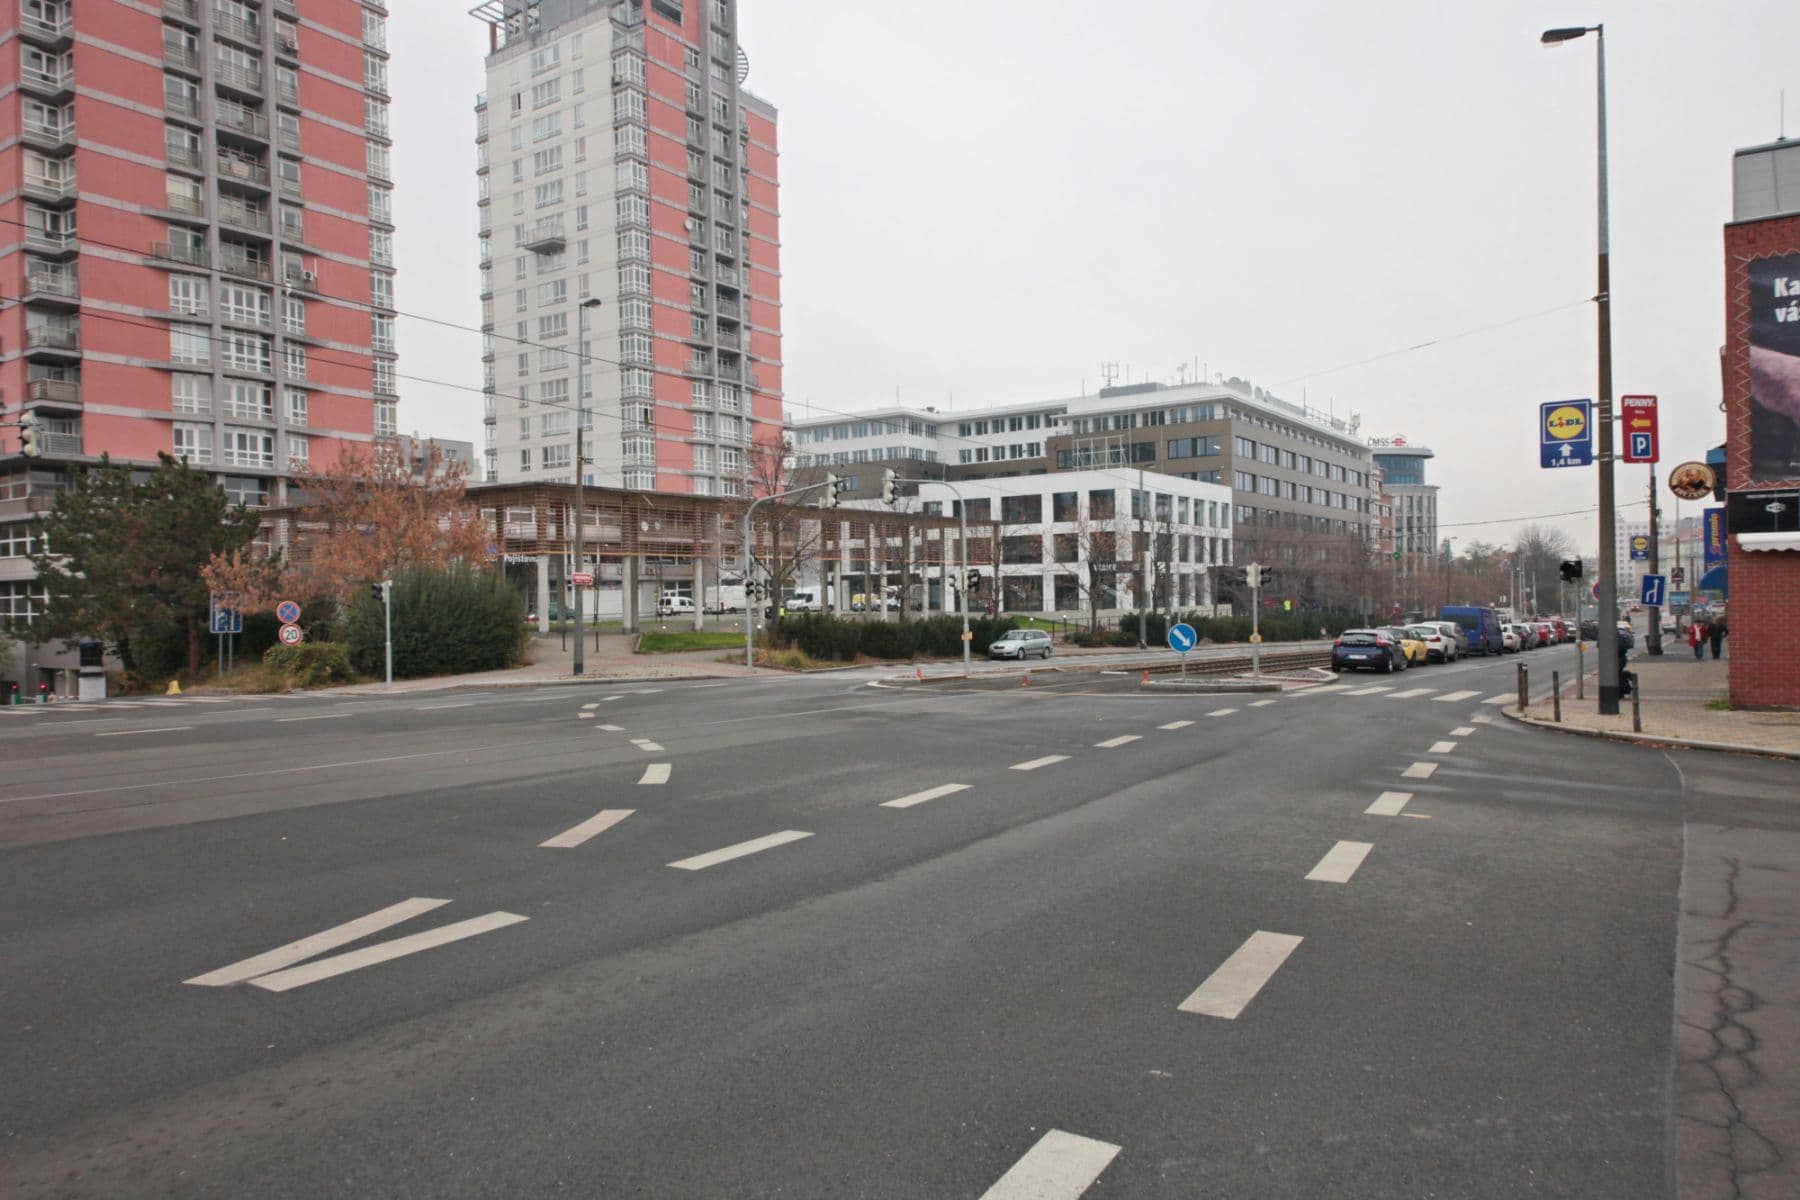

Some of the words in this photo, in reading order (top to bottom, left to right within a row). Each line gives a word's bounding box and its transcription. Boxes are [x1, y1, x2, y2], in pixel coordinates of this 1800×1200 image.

[1775, 300, 1800, 322] vá
[1549, 416, 1584, 428] LIDL
[1636, 437, 1647, 454] P
[1551, 457, 1565, 468] 1,4
[1567, 456, 1582, 465] km
[285, 629, 298, 640] 20
